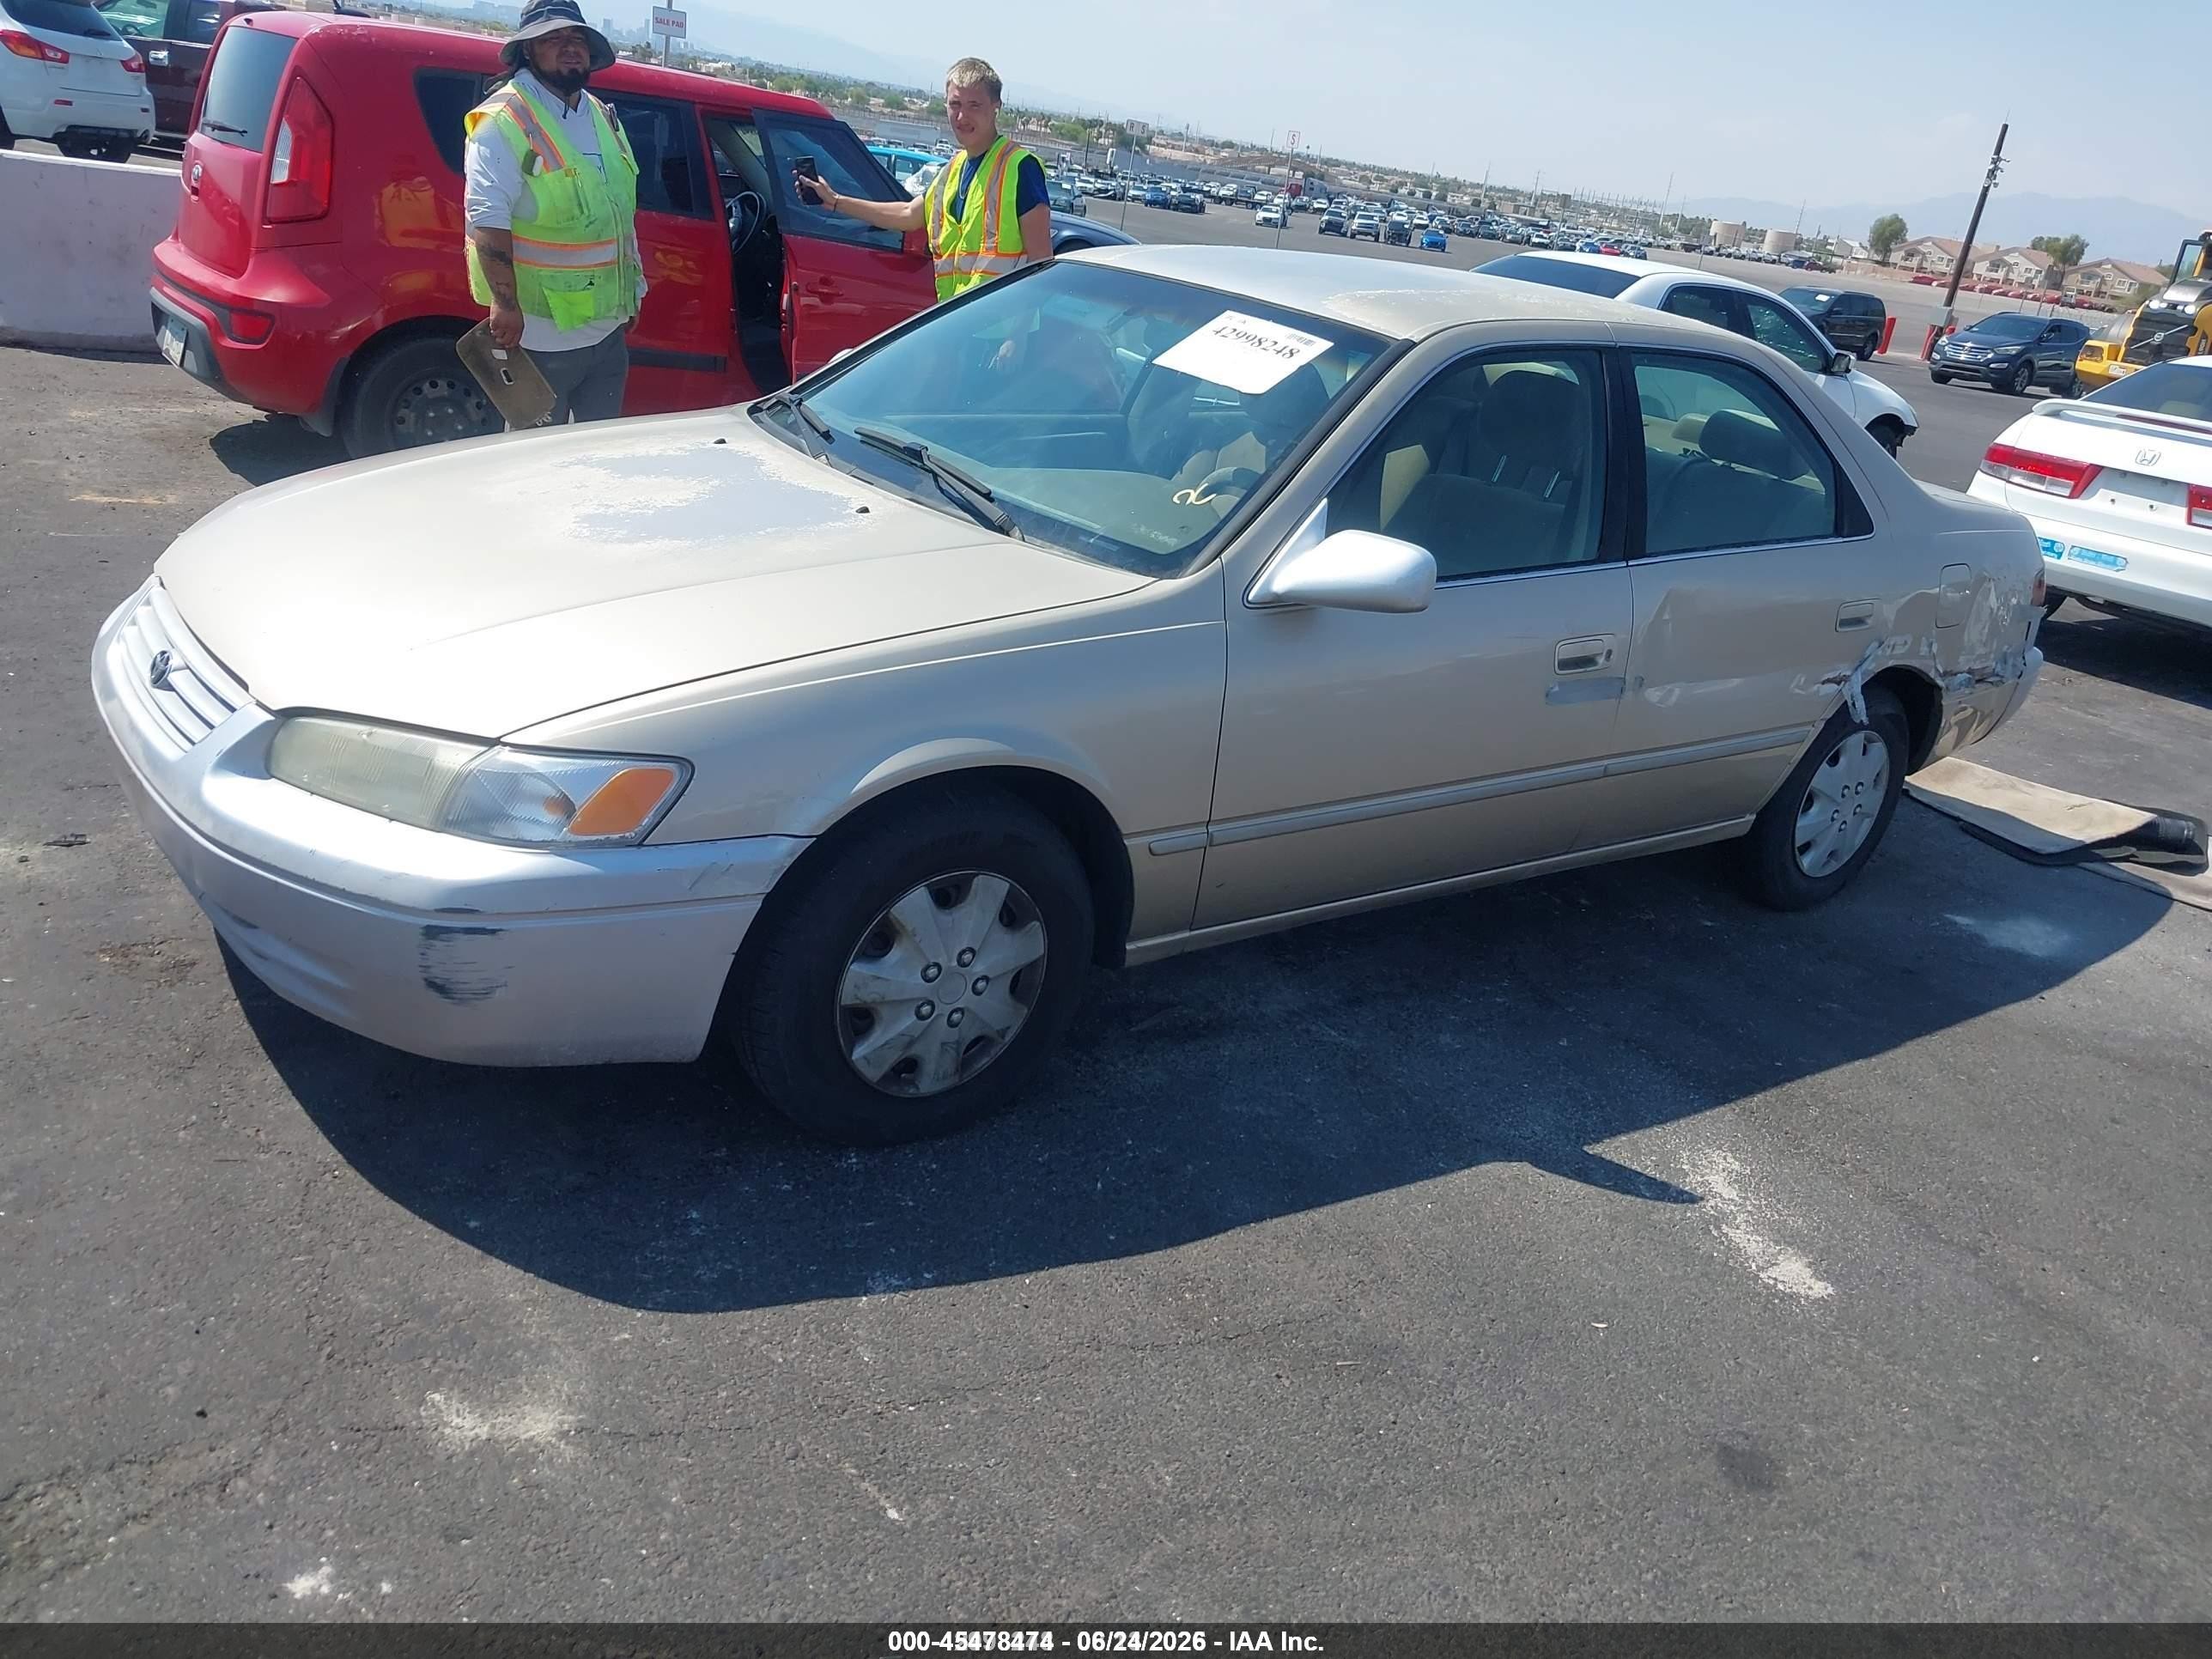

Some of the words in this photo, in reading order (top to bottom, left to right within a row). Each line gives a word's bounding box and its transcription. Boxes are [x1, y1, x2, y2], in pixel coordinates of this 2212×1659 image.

[654, 16, 670, 26] SALE
[672, 20, 684, 28] PAD
[1140, 125, 1146, 135] S
[1290, 133, 1296, 145] S
[1212, 325, 1301, 359] 42998248
